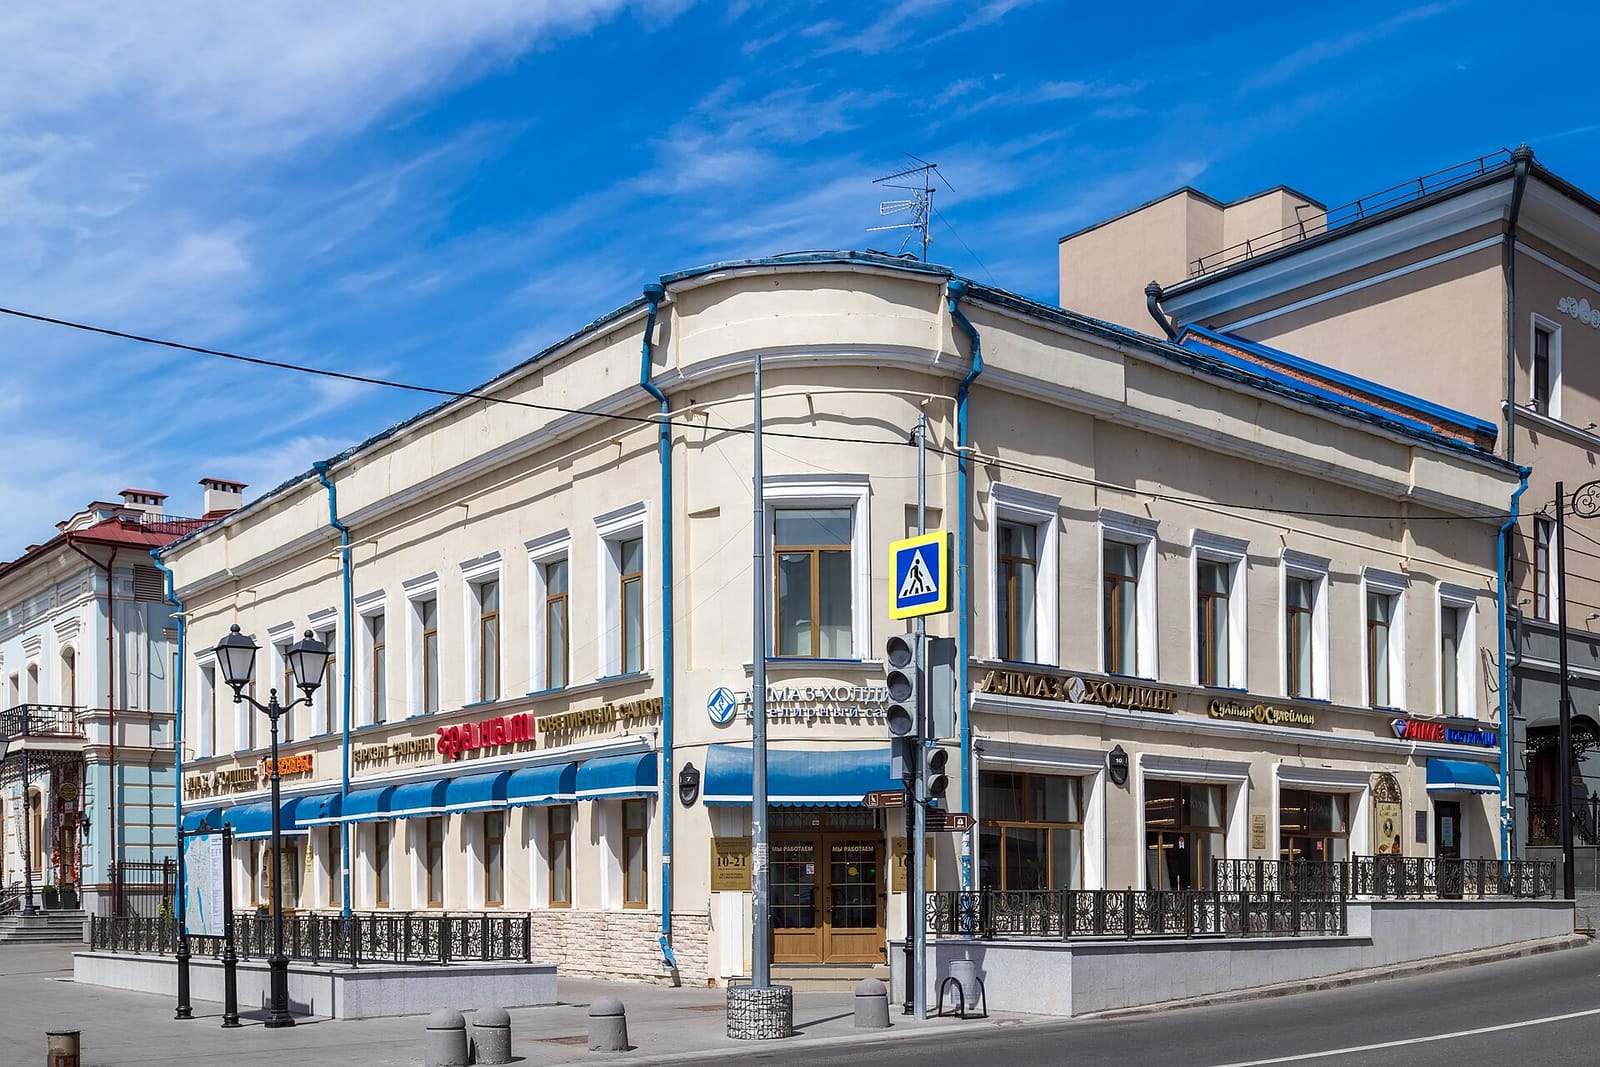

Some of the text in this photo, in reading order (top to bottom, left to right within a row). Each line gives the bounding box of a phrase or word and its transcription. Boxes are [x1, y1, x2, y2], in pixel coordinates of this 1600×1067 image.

[981, 670, 1176, 711] АЛМАЗ ХОЛДИНГ
[538, 697, 663, 732] ЮВЕЛИРНЫЙ САЛОН
[745, 706, 858, 720] юелирный
[392, 737, 435, 757] САЛОНЫ
[717, 857, 746, 867] 10-21
